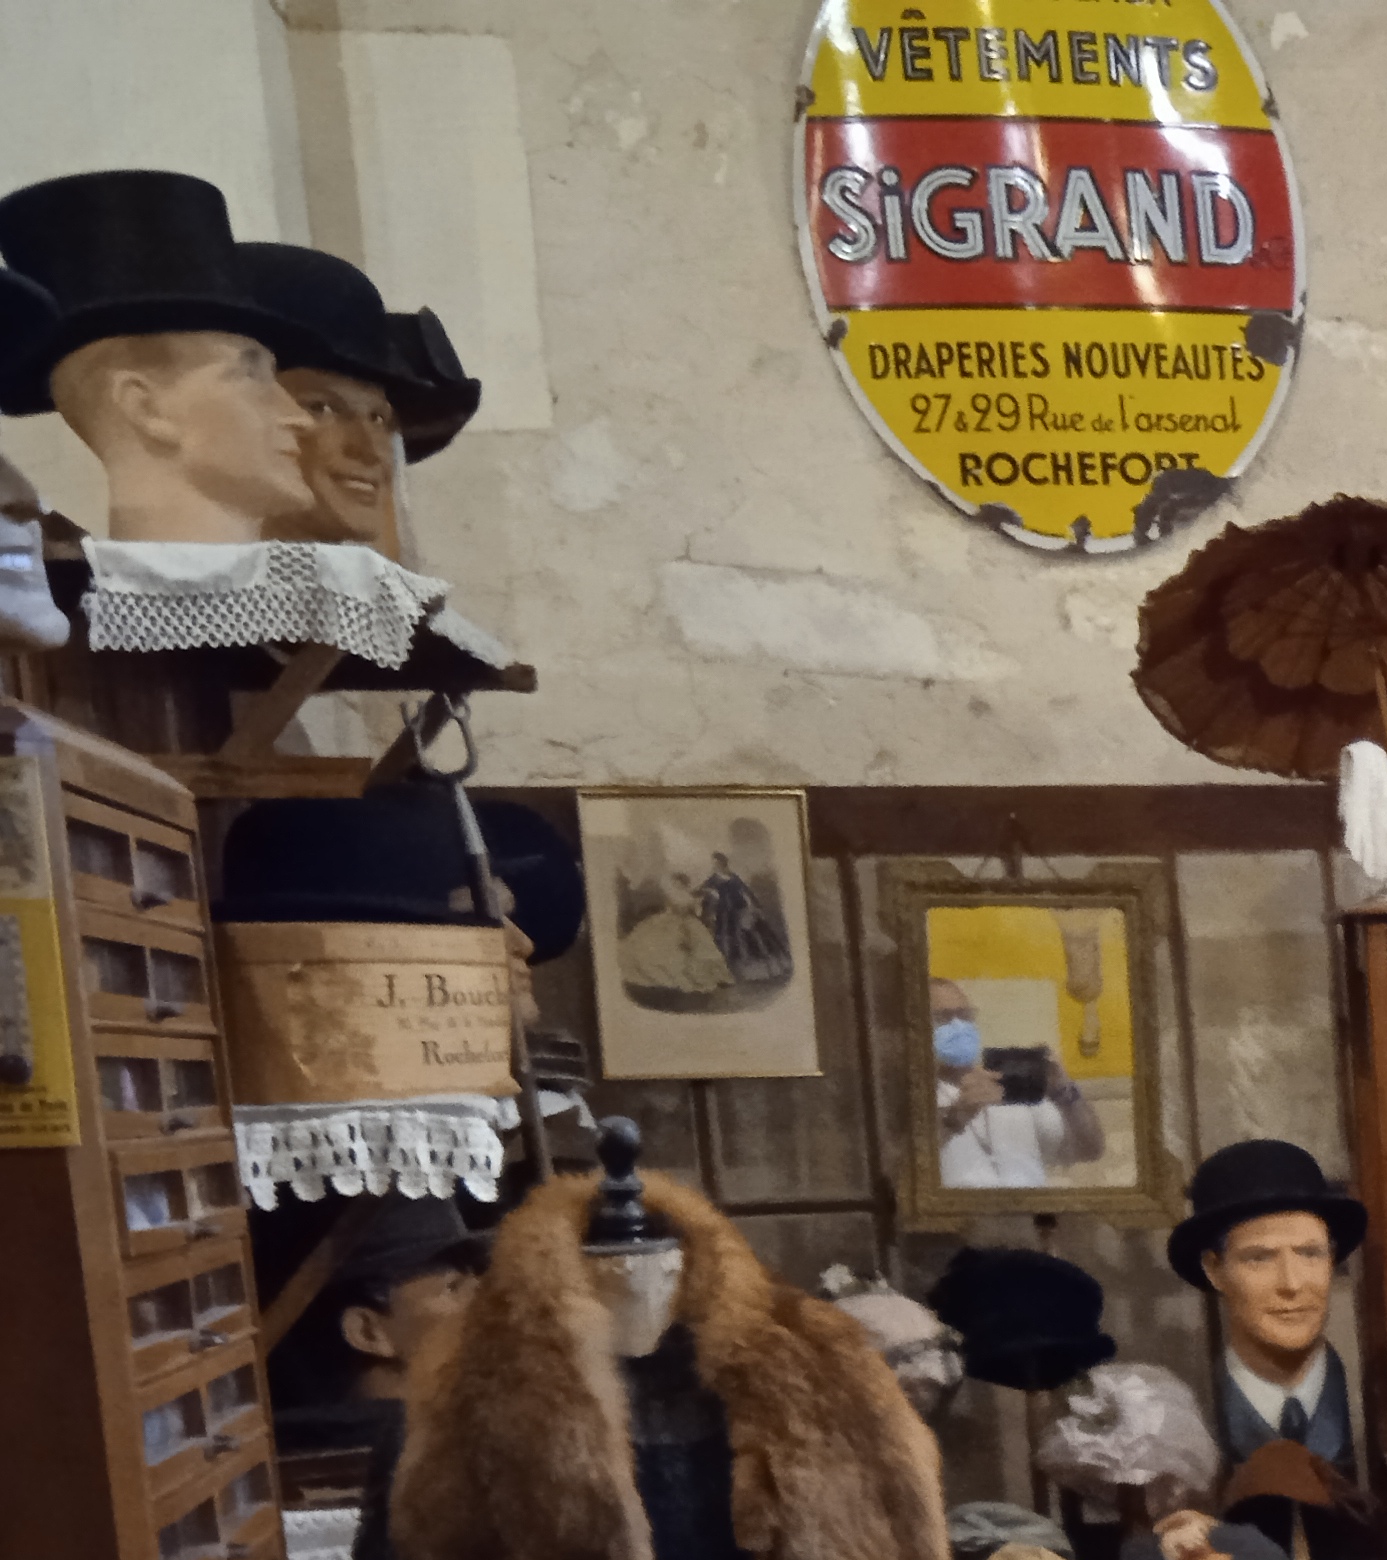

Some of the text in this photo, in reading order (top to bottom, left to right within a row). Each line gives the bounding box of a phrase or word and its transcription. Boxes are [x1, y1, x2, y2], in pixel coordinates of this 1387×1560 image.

[852, 10, 1219, 94] VÊTEMENTS
[868, 340, 1051, 382] DRAPERIES
[1026, 393, 1085, 433] Rue
[423, 973, 511, 1008] Bouch
